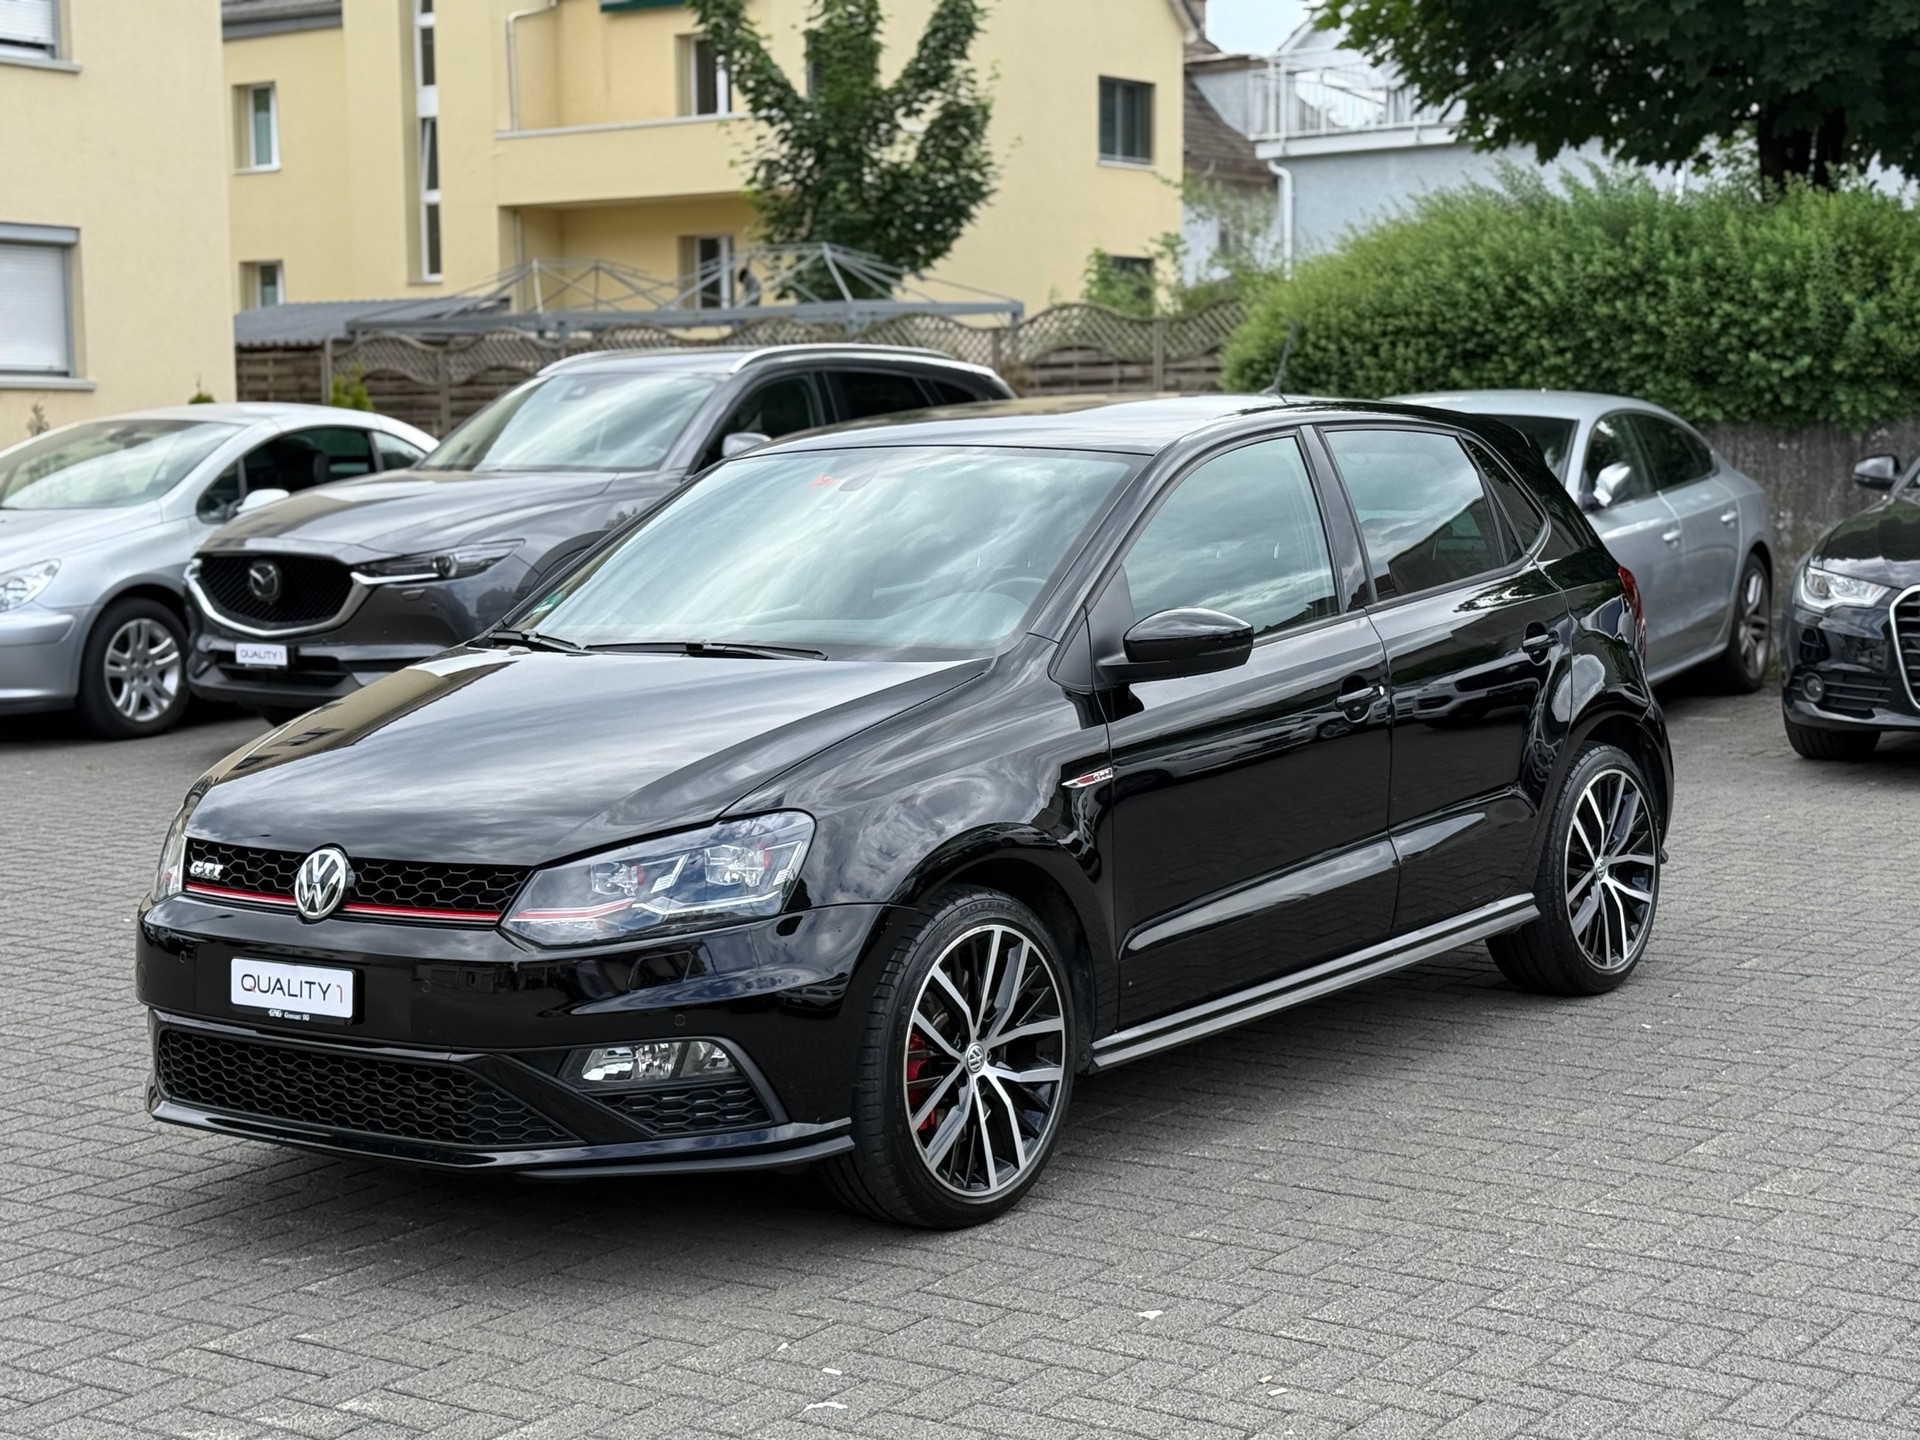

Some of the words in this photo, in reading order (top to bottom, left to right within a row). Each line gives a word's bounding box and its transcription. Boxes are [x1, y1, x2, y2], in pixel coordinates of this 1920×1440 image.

[240, 649, 278, 660] QUALITY
[190, 861, 223, 880] GTI
[241, 974, 331, 1001] QUALITY
[336, 984, 343, 1003] 1
